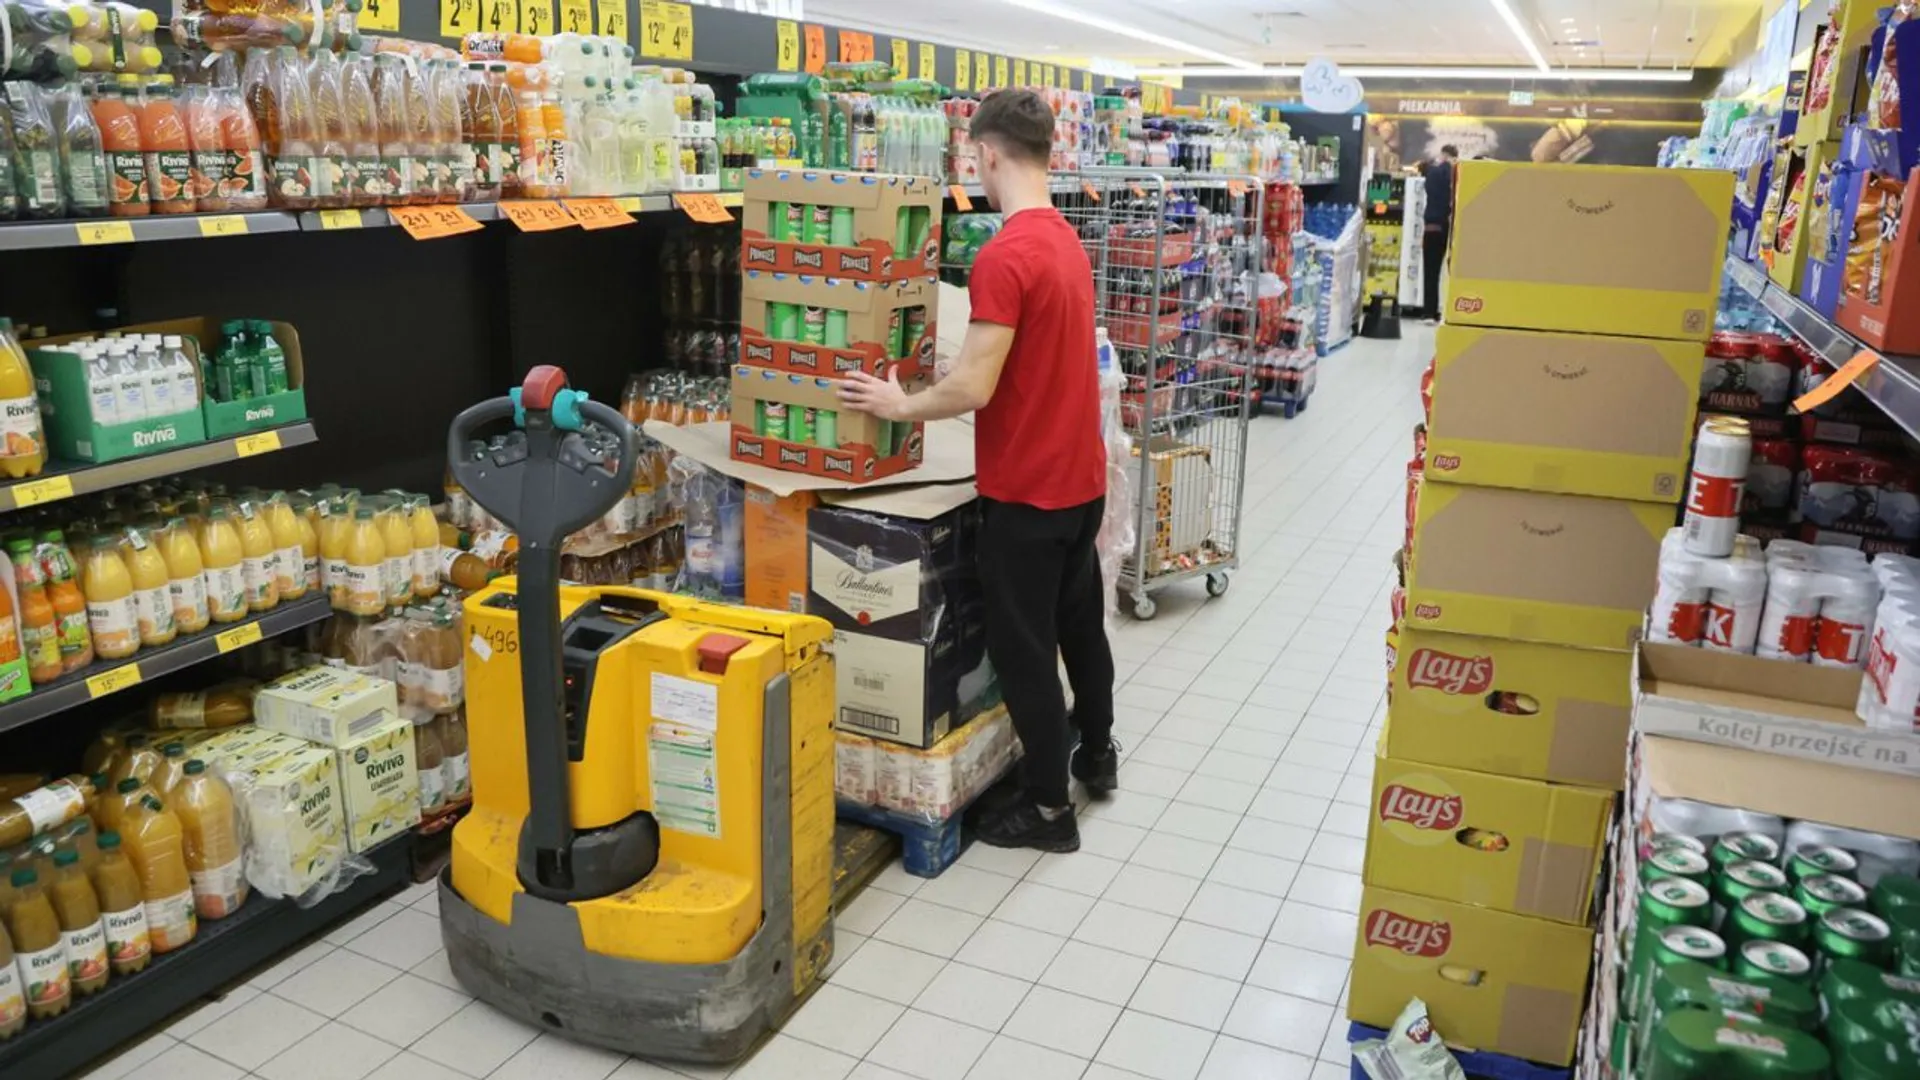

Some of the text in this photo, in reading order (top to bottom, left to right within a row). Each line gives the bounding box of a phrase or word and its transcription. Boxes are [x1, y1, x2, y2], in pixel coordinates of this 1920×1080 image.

[1399, 99, 1462, 113] PIEKARNIA
[402, 208, 460, 227] 2+1 2+1
[511, 205, 561, 221] 2+1 2+1
[575, 203, 618, 219] 2+1 2+1
[794, 250, 822, 268] PRINGLES
[841, 254, 870, 273] PRINGLES
[1709, 391, 1760, 408] HARNAS
[245, 405, 275, 421] Riviva
[132, 425, 177, 448] Riviva
[1411, 650, 1490, 694] Lay's
[1698, 717, 1909, 764] Kolej przejść na
[366, 753, 405, 780] Riviva
[1383, 786, 1459, 828] Lay's
[1368, 911, 1444, 954] Lay's
